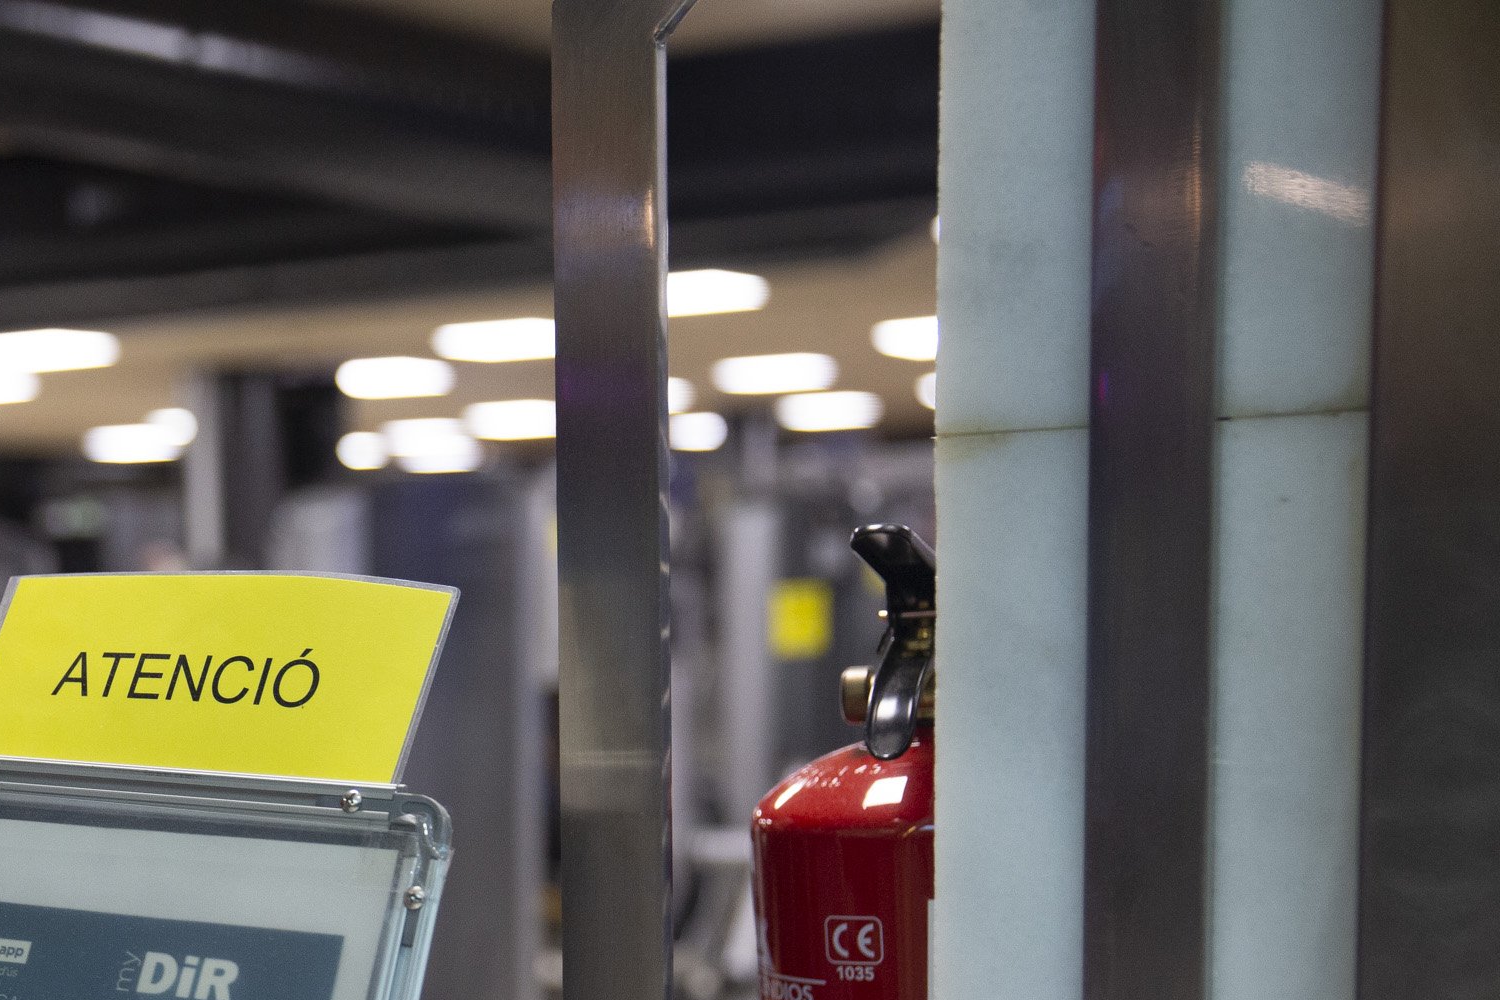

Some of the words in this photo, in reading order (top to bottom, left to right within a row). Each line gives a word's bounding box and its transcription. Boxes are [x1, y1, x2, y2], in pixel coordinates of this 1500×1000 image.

[51, 648, 320, 708] ATENCIÓ
[832, 922, 876, 959] CE
[836, 965, 875, 982] 1035
